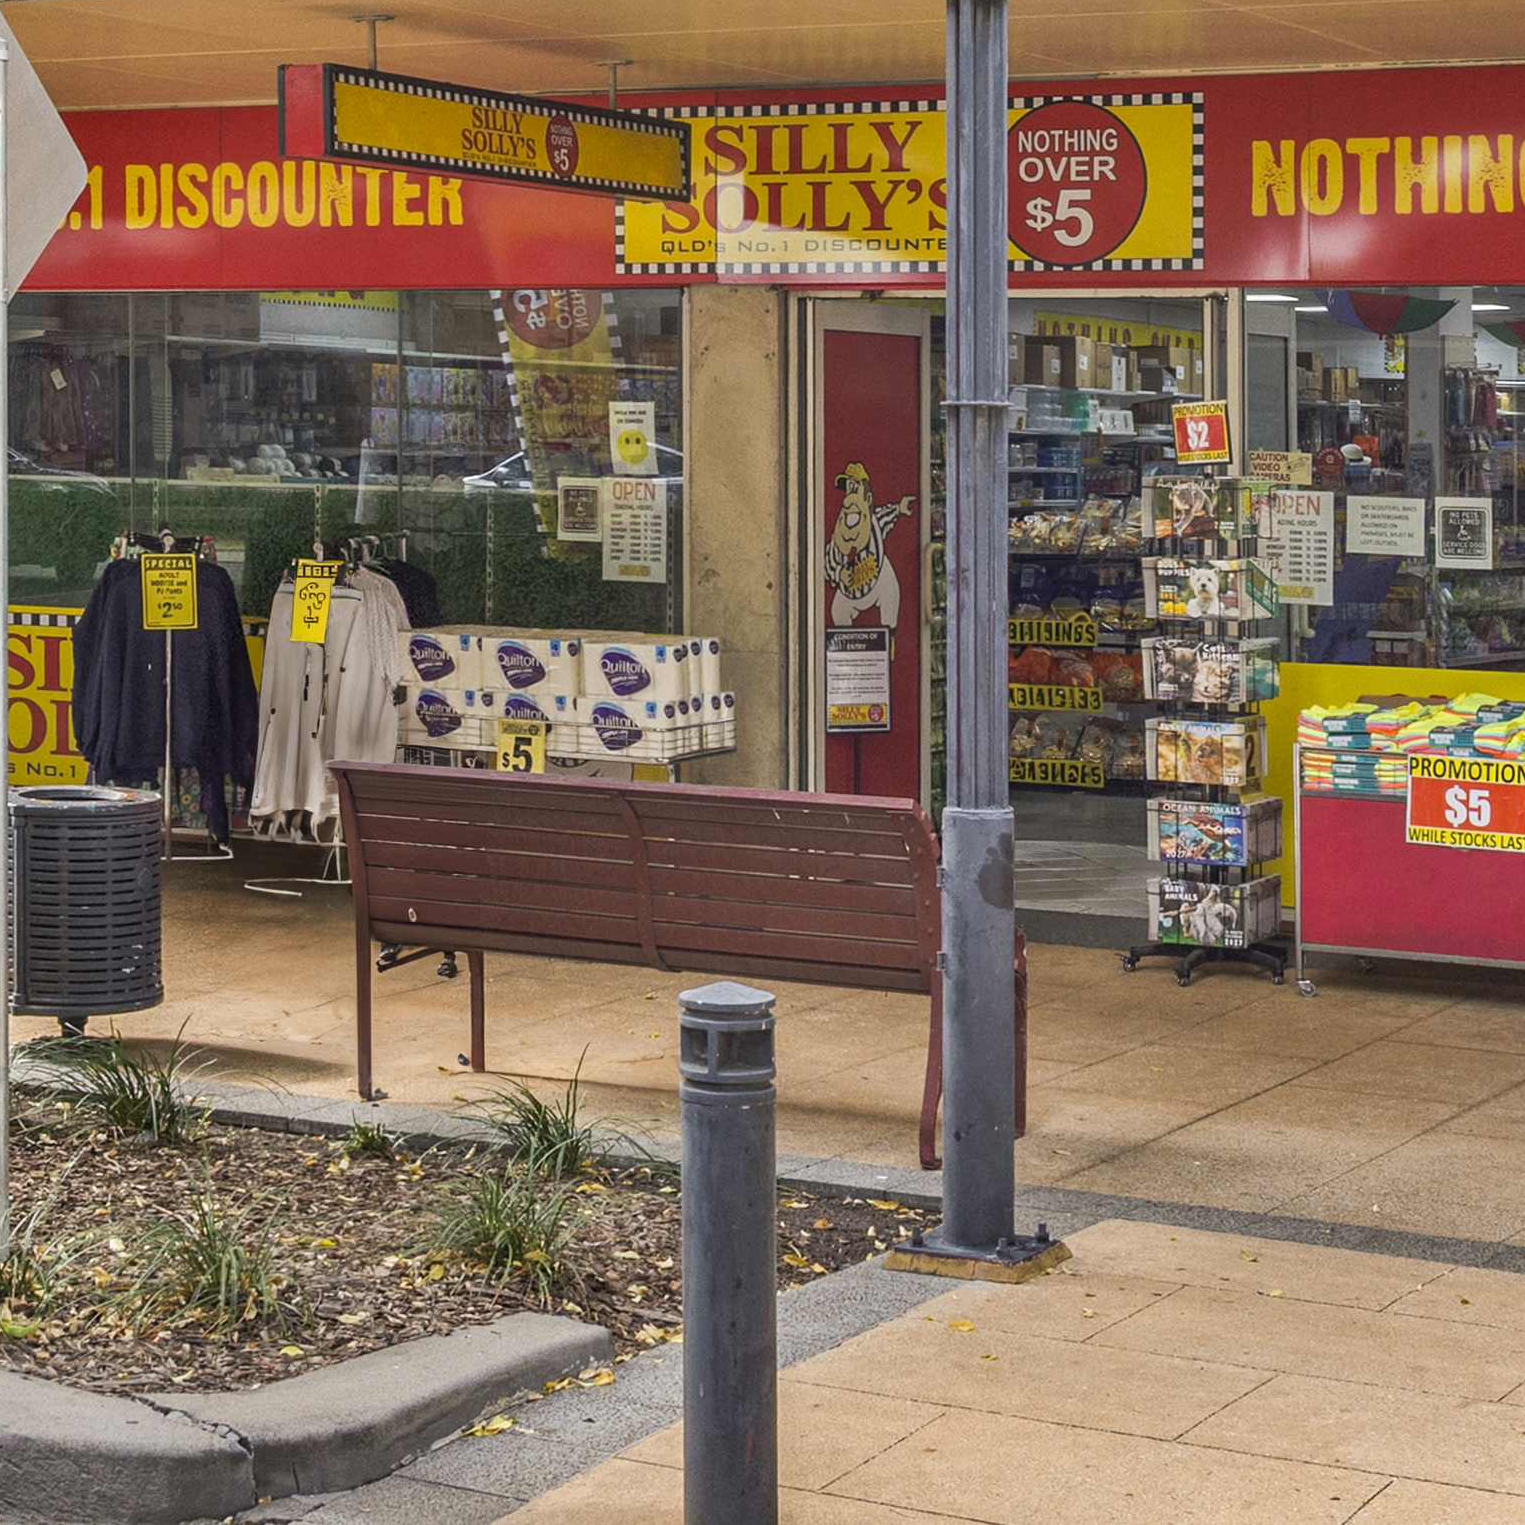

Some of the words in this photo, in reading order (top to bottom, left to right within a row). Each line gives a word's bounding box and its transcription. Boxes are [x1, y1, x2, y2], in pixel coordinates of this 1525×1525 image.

[472, 106, 523, 134] SILLY
[462, 128, 536, 159] SOLLY'S
[551, 135, 573, 147] OVER
[704, 121, 923, 176] SILLY
[1018, 128, 1119, 154] NOTHING
[554, 149, 569, 171] $5
[1018, 156, 1117, 183] OVER
[126, 160, 465, 230] DISCOUNTER
[1025, 188, 1094, 248] $5
[738, 240, 789, 254] No.1
[805, 238, 947, 253] DISCOUNTE
[1187, 418, 1209, 450] $2
[1249, 453, 1289, 462] CAUTION
[1252, 463, 1280, 472] VIDEO
[613, 481, 656, 501] OPEN
[1443, 541, 1468, 549] SERVICE
[145, 559, 192, 568] SPECIAL
[410, 646, 451, 661] Quilton
[1203, 644, 1226, 652] Cats
[497, 653, 542, 667] Quilton
[1203, 653, 1240, 661] Kittens
[600, 658, 646, 674] Quilton
[504, 705, 547, 720] Quilton
[591, 713, 637, 728] Quilton
[502, 737, 533, 773] $5
[27, 763, 76, 778] No.1
[1162, 803, 1196, 812] OCEAN
[1200, 806, 1241, 815] ANIMALS
[1444, 785, 1491, 827] $5
[1409, 827, 1446, 844] WHILE
[1450, 832, 1496, 847] STOCKS
[1164, 893, 1198, 901] ANIMALS
